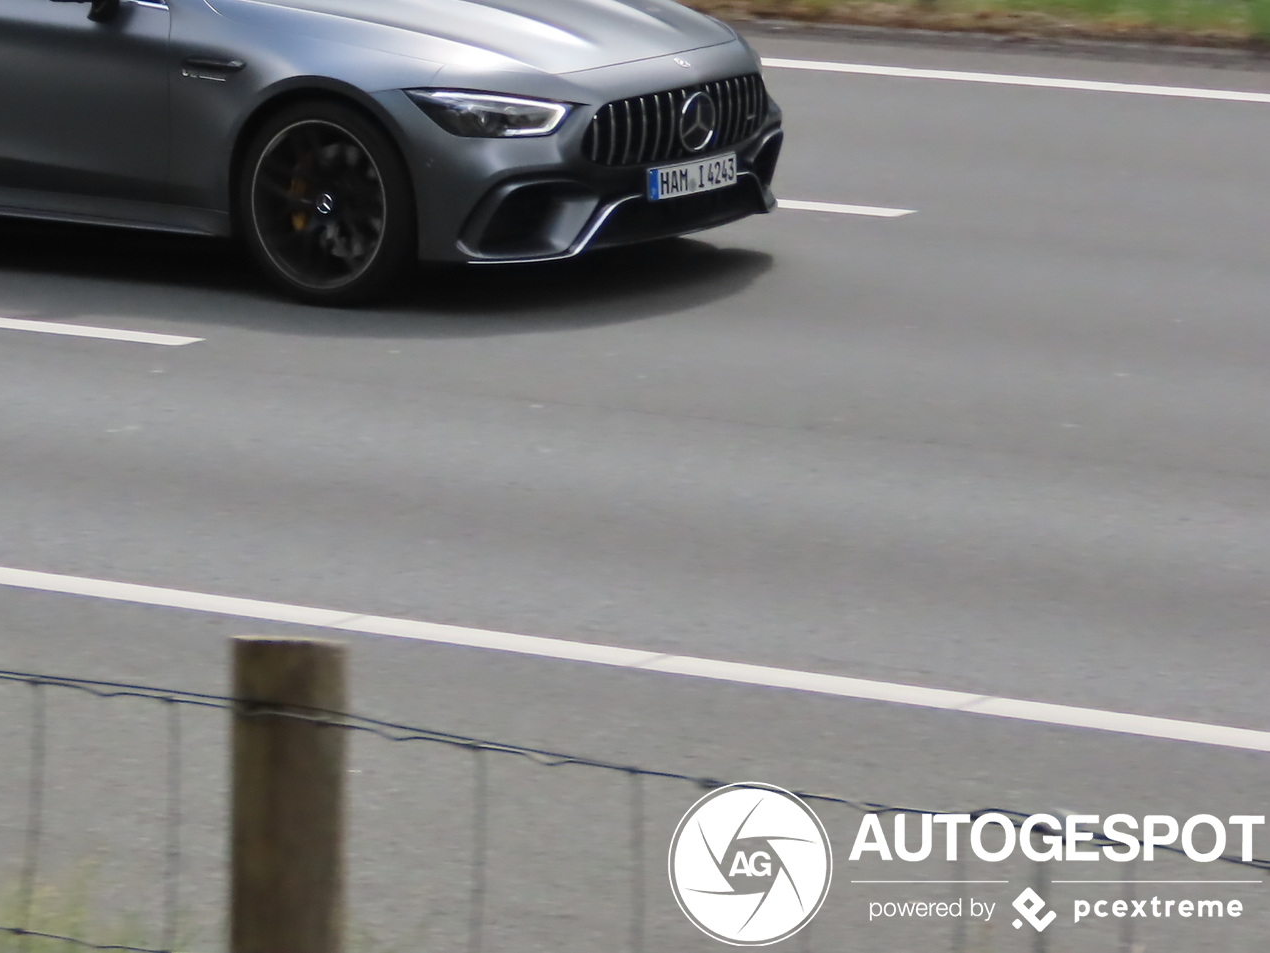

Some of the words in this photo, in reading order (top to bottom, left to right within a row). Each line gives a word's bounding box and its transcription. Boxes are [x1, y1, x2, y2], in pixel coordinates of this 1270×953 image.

[660, 168, 688, 195] HAM
[698, 165, 705, 188] I
[707, 158, 734, 185] 4243
